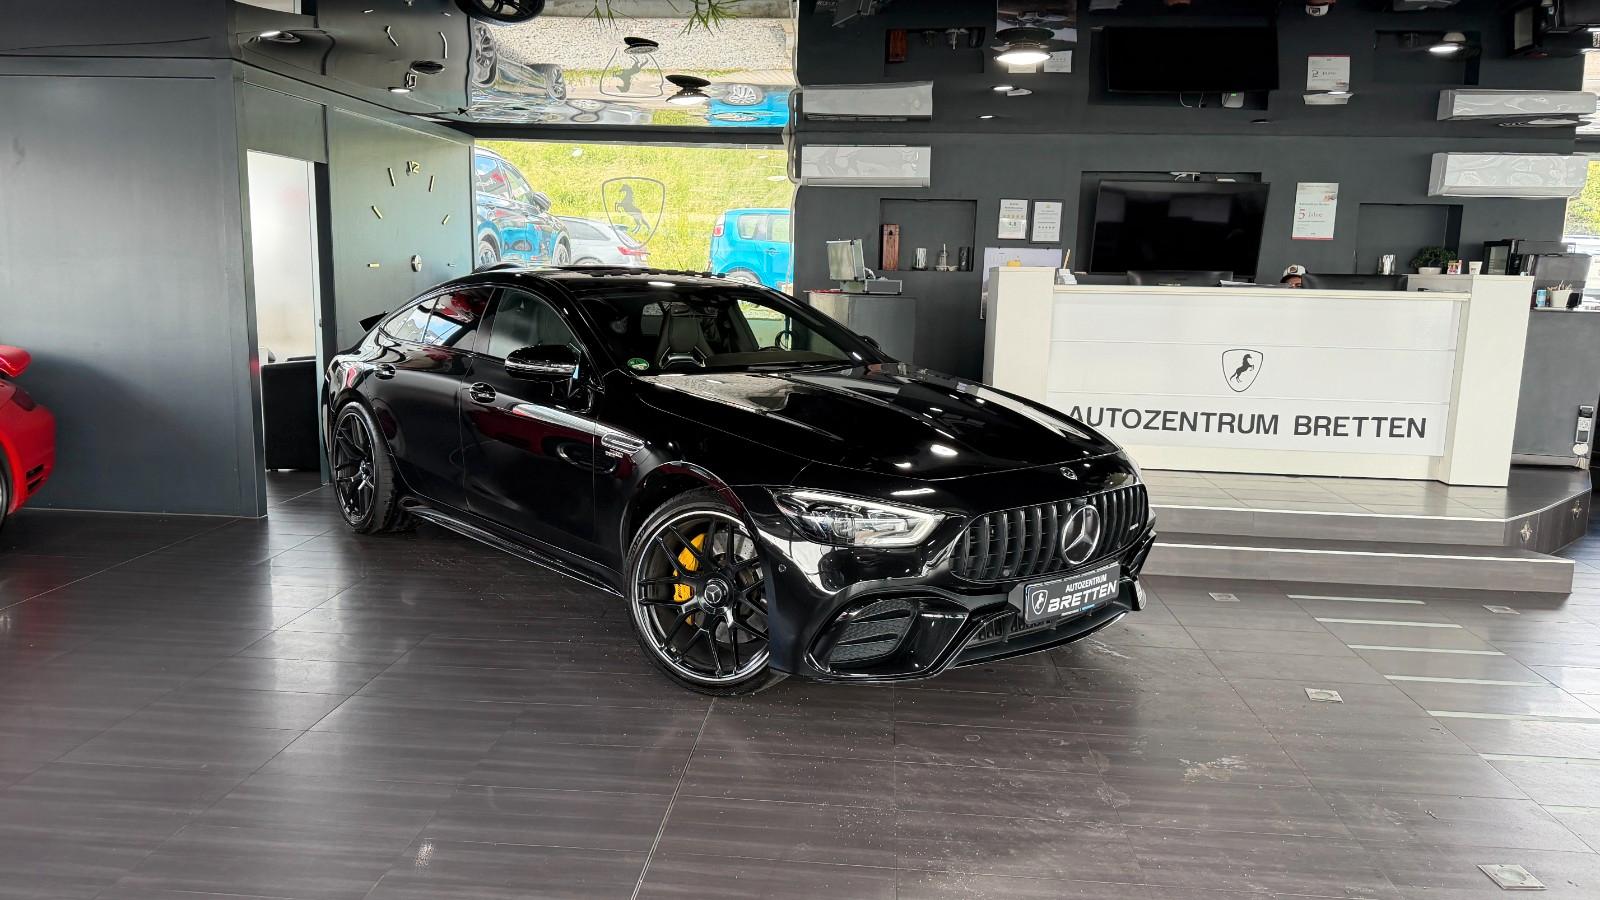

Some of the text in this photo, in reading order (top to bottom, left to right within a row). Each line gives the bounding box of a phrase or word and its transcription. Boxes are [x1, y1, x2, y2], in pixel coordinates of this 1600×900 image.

[1069, 405, 1426, 438] AUTOZENTRUM BRETTEN
[1047, 580, 1118, 613] BRETTEN
[1065, 573, 1108, 593] AUTOZENTRUM
